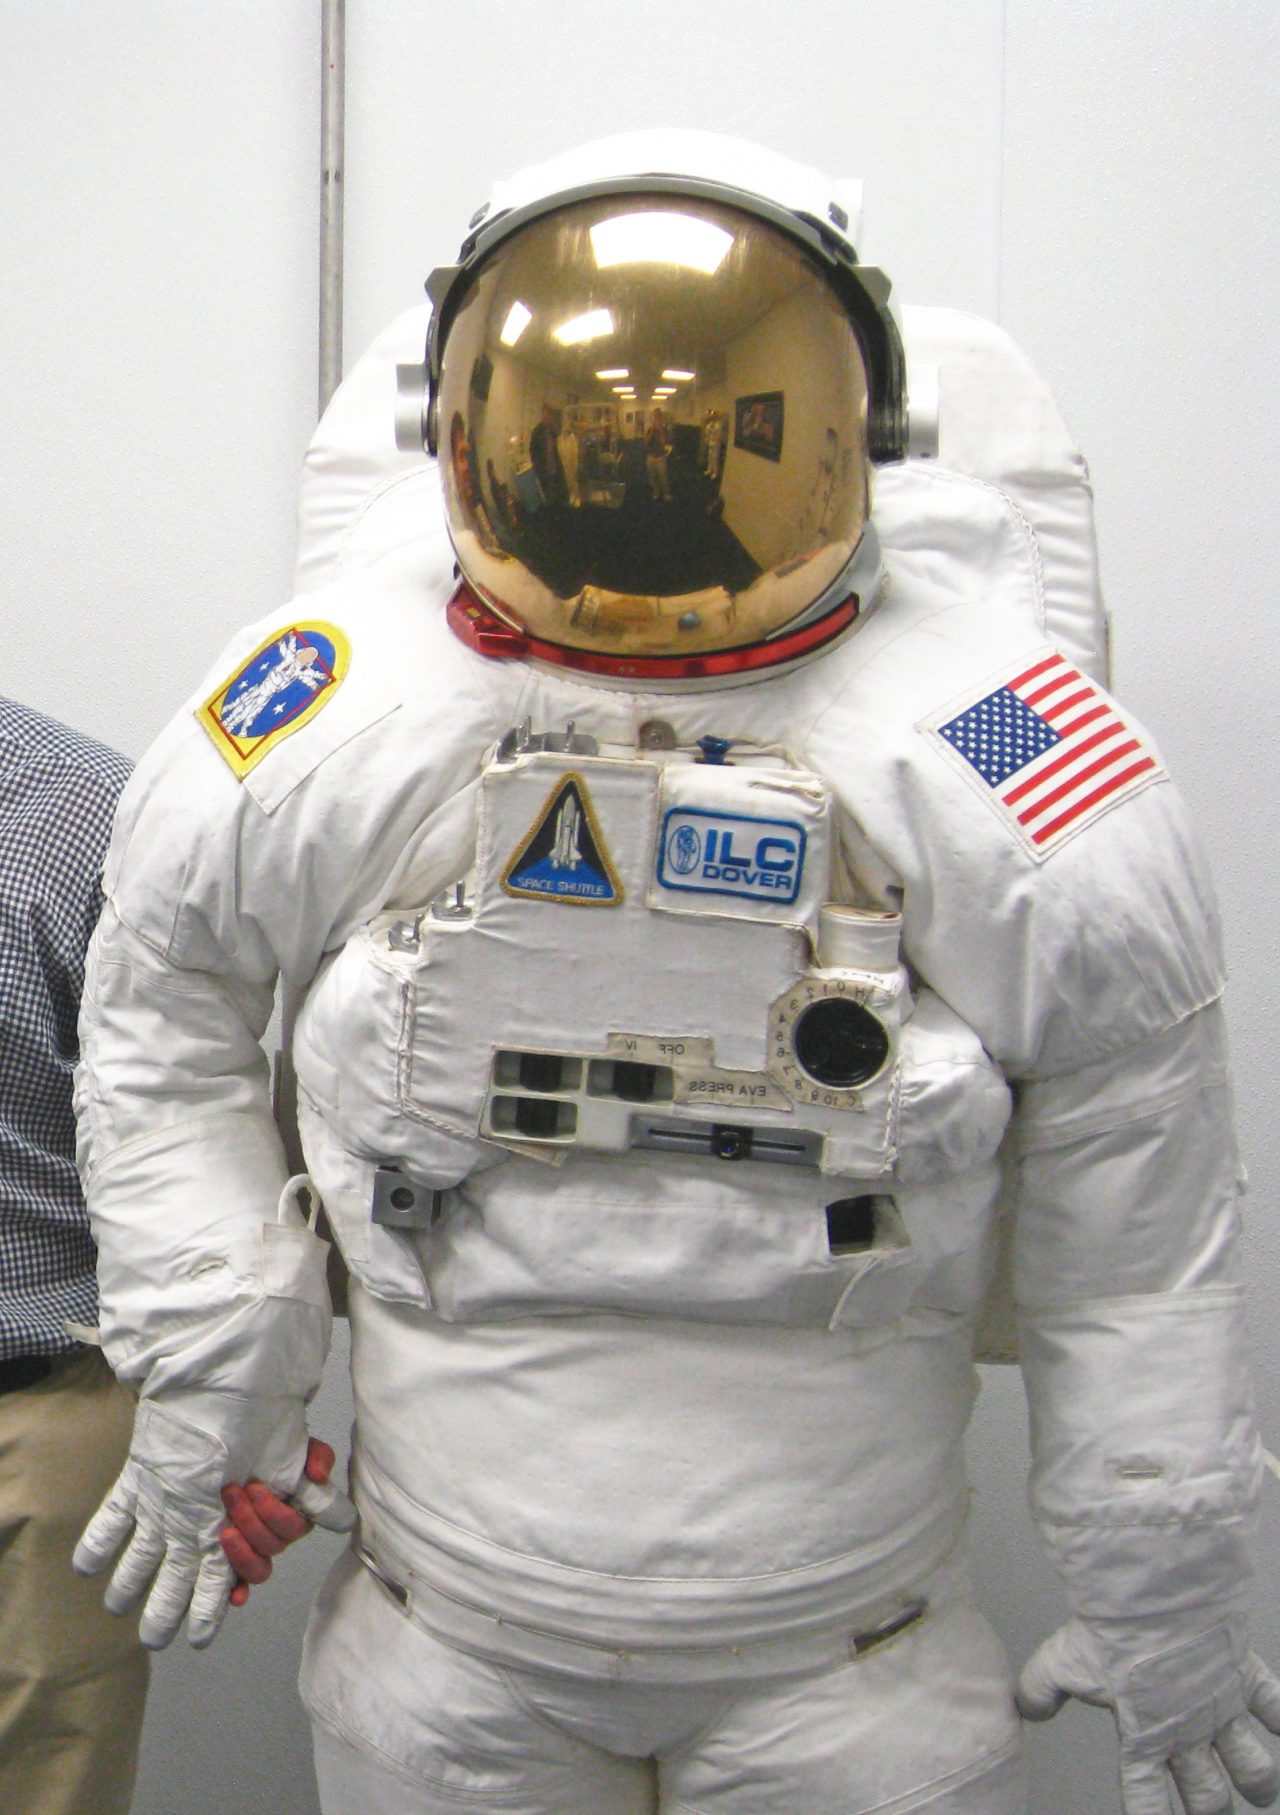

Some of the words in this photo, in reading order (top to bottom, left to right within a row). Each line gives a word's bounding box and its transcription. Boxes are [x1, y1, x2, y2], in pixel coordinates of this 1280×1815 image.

[704, 828, 796, 873] ILC
[518, 877, 554, 891] SPACE
[558, 881, 605, 896] SHUTTLE
[702, 863, 794, 890] DOVER
